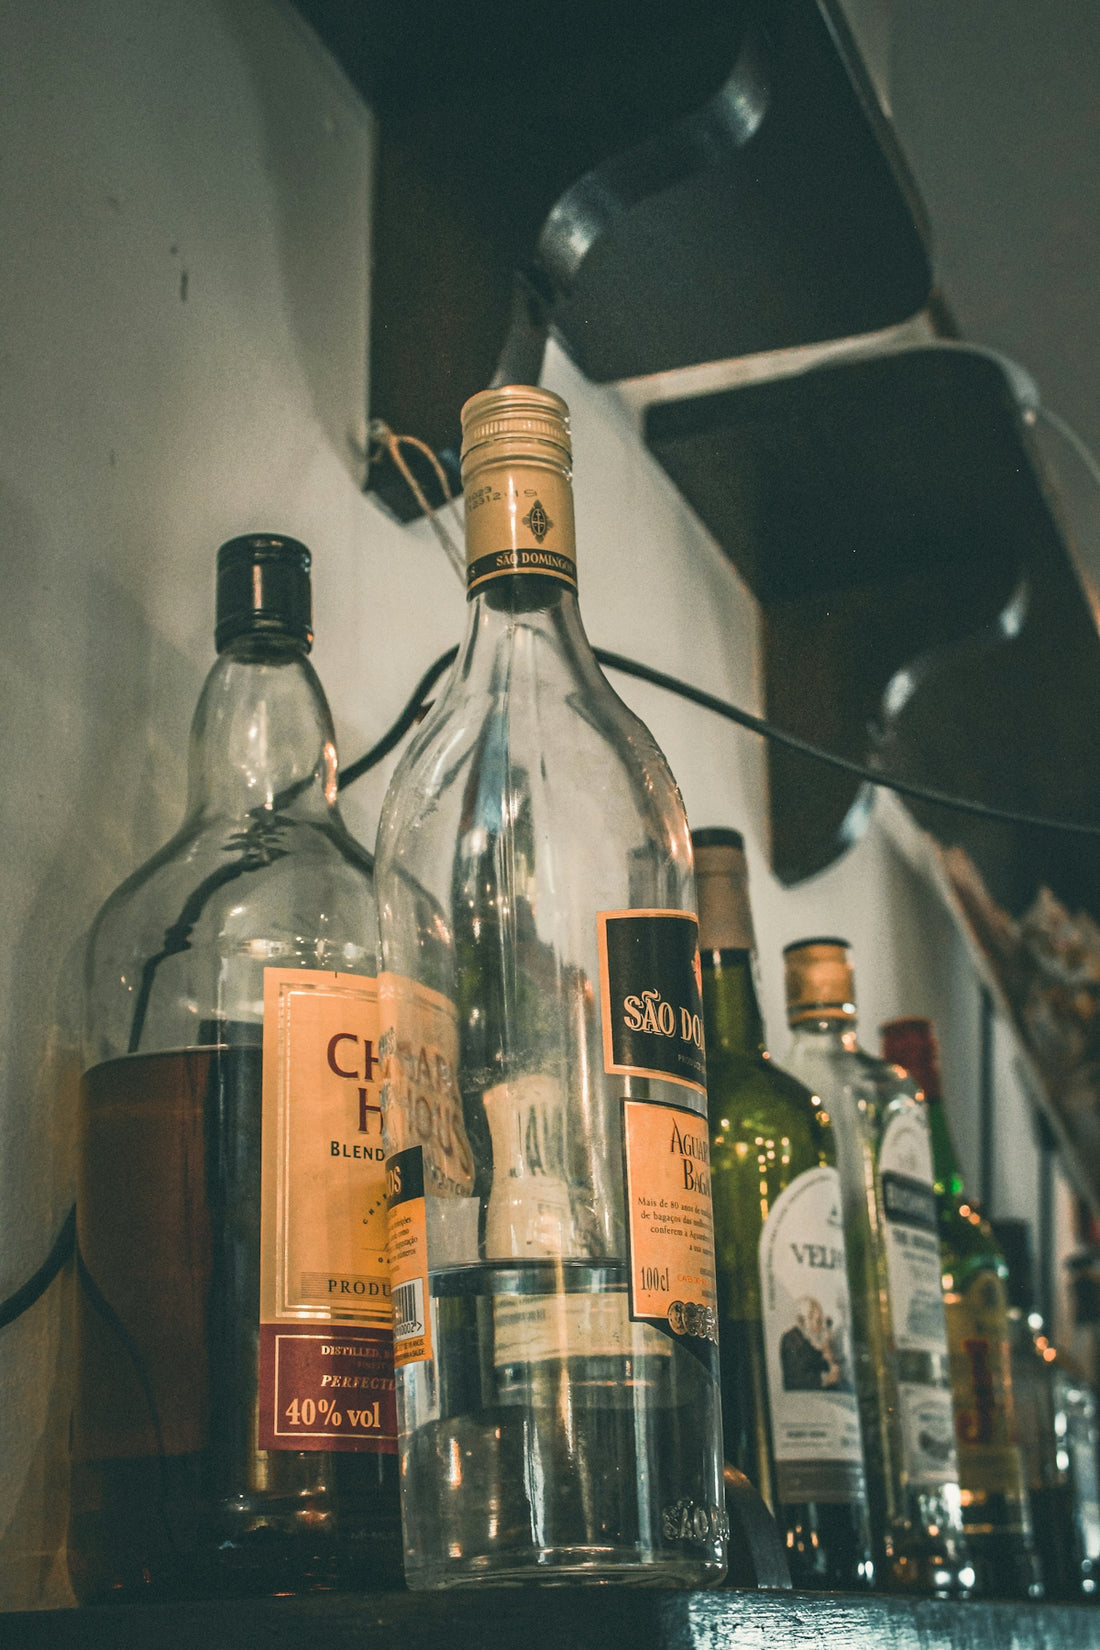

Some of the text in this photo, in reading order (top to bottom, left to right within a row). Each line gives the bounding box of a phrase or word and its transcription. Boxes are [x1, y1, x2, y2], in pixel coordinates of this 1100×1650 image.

[623, 988, 704, 1050] SÃO DO
[638, 1197, 657, 1207] Mais
[659, 1198, 669, 1208] de
[670, 1201, 680, 1210] 80
[641, 1210, 651, 1220] de
[653, 1211, 681, 1224] bagaços
[650, 1225, 683, 1236] conferem
[285, 1398, 381, 1428] 40% vol
